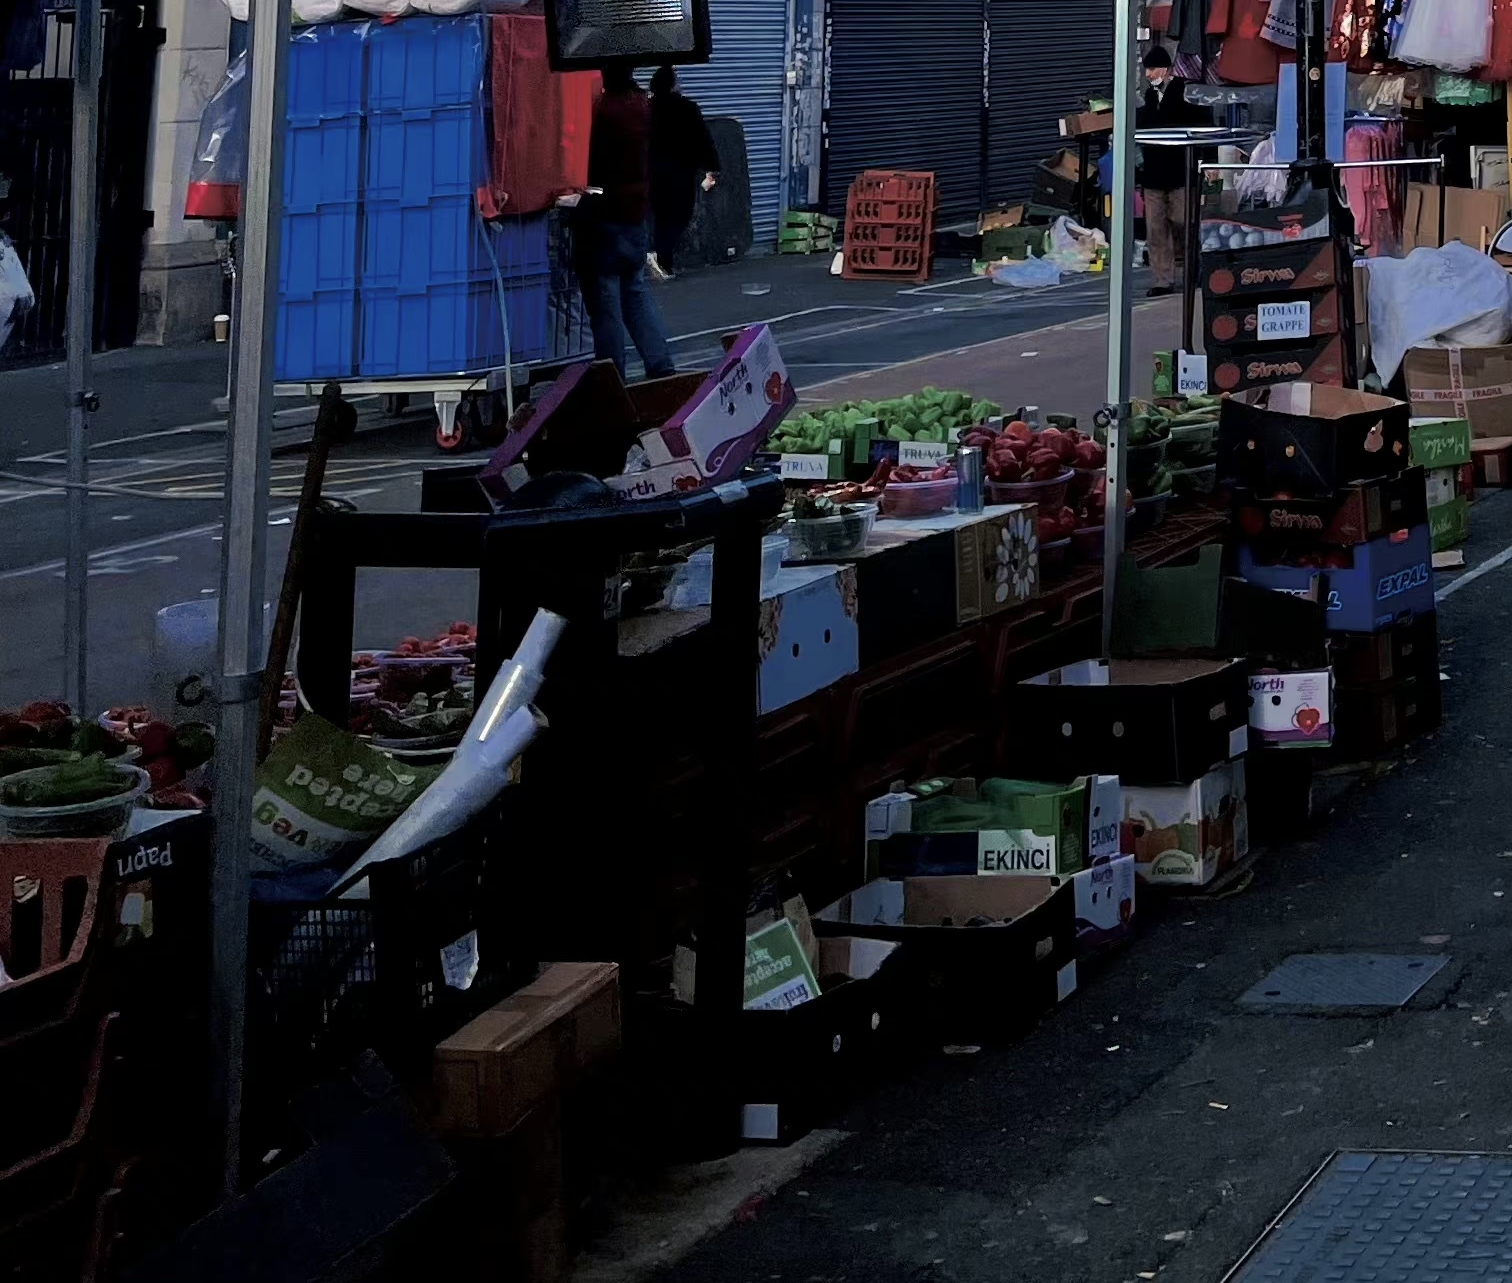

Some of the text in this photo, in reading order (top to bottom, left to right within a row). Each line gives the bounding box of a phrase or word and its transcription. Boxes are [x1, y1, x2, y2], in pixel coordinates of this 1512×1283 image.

[1261, 303, 1306, 317] TOMATE
[1261, 319, 1305, 333] GRAPPE
[617, 480, 656, 499] orth
